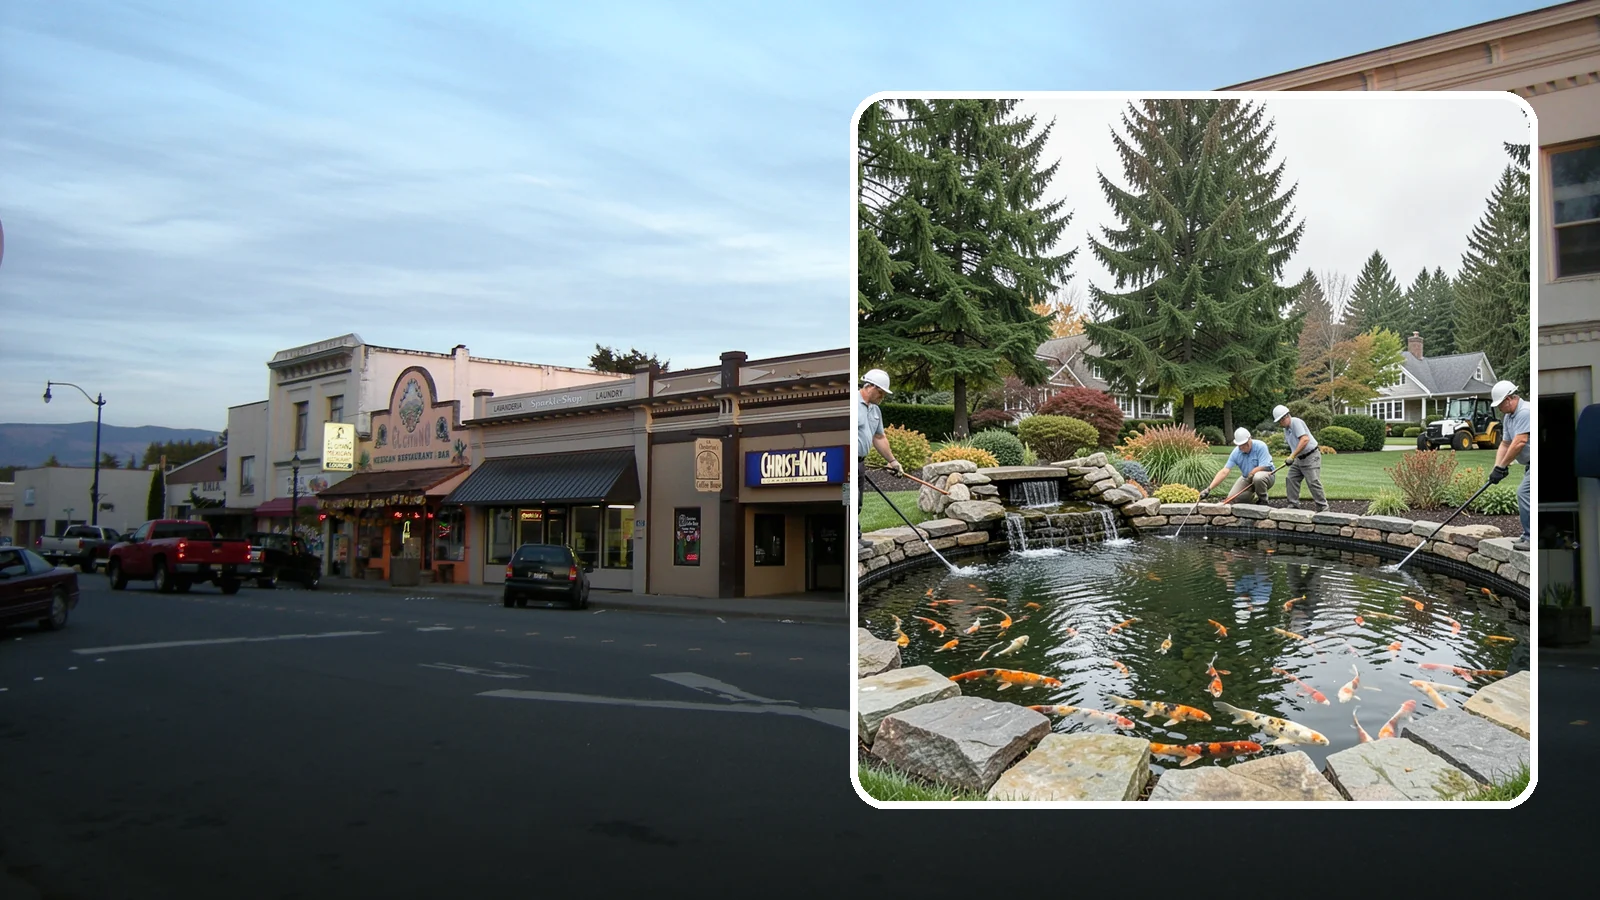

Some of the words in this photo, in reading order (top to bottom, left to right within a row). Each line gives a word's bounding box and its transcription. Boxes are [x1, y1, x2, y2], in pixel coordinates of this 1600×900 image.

[562, 394, 583, 404] Shop
[595, 389, 623, 400] LAUNDRY
[494, 402, 522, 412] LAVANDERIA
[373, 455, 396, 464] MEXICAN
[398, 451, 433, 462] RESTAURANT
[438, 450, 450, 459] BAR
[761, 451, 797, 478] CHRIST
[799, 450, 828, 476] KING
[696, 480, 709, 489] Coffee
[710, 480, 722, 489] House
